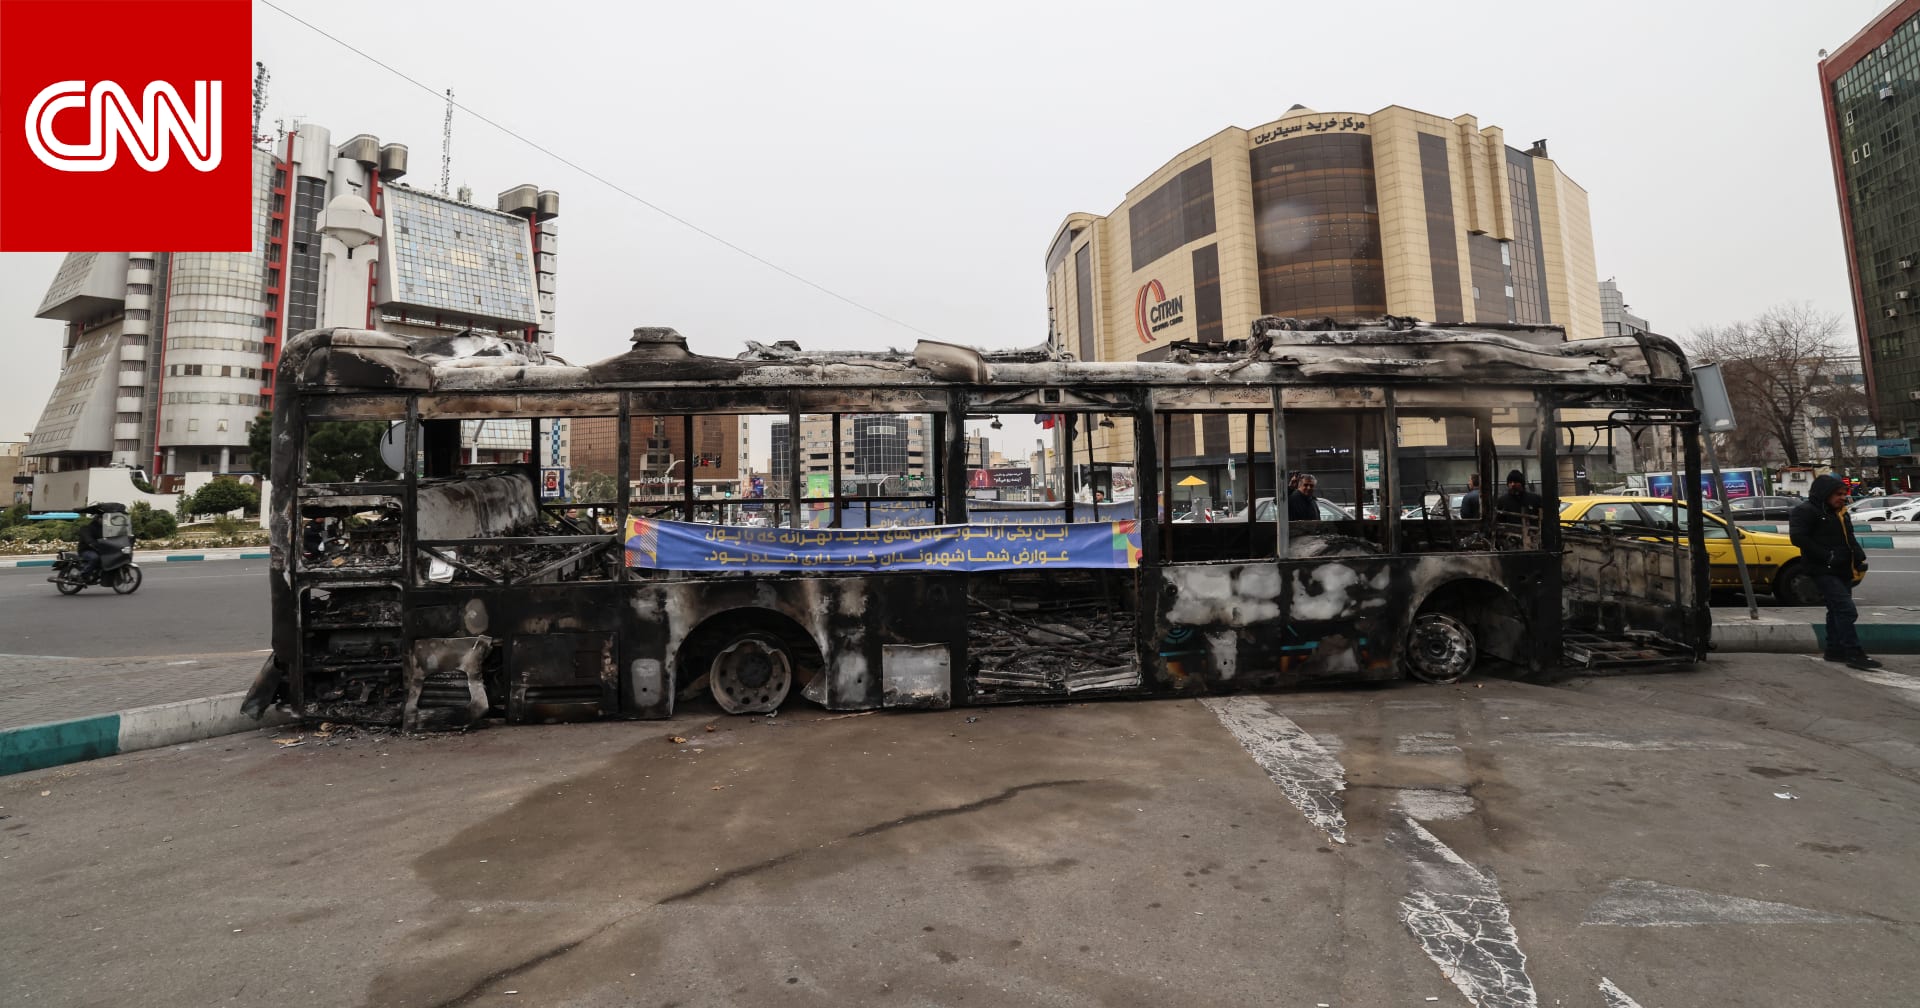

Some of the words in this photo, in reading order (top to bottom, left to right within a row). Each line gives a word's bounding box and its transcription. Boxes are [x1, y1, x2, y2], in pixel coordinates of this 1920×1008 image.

[1306, 117, 1338, 132] خرید
[1339, 116, 1366, 131] مرکز
[1254, 123, 1303, 145] سیترین
[1150, 295, 1184, 324] CITRIN
[705, 527, 742, 546] پول
[743, 530, 754, 545] با
[757, 531, 777, 543] که
[835, 530, 880, 545] جدید
[1006, 526, 1033, 541] یکی
[1034, 525, 1069, 541] این
[704, 550, 749, 566] بود.
[751, 552, 798, 563] شده
[801, 550, 877, 566] خریداری
[880, 548, 965, 566] شهروندان
[967, 548, 1010, 562] شما
[1012, 547, 1070, 565] عوارض
